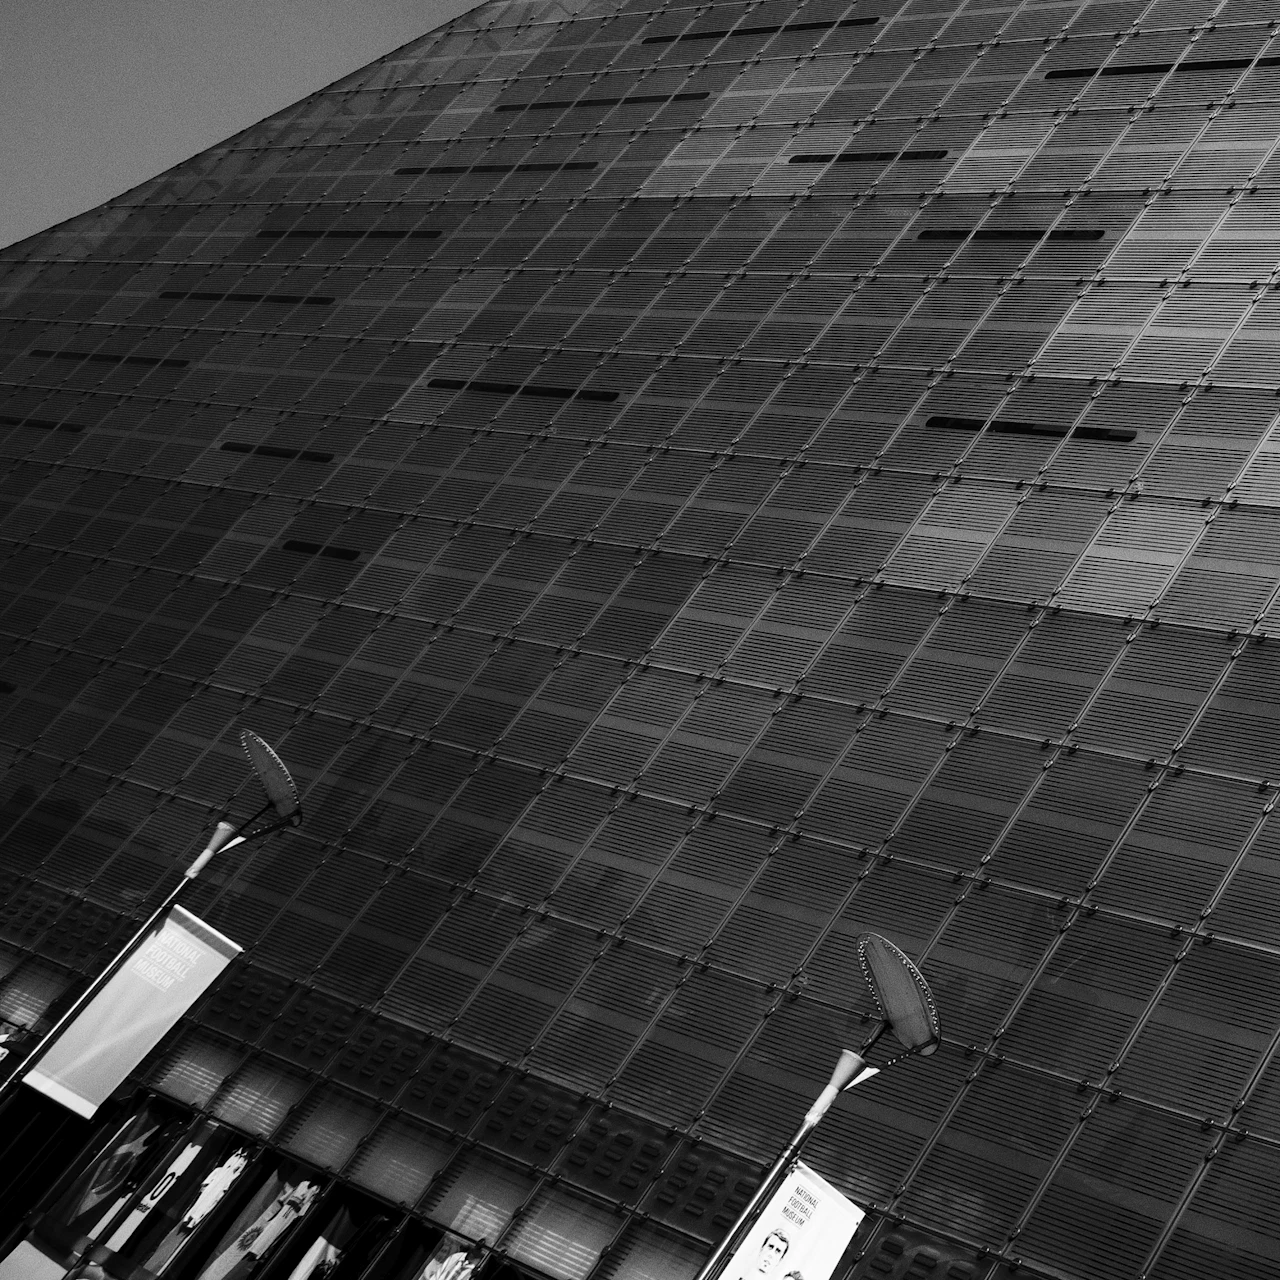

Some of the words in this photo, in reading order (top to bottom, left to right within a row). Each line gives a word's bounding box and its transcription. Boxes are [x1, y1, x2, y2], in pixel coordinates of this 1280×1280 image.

[157, 930, 202, 965] NATIONAL
[133, 958, 175, 989] MUSEUM
[145, 945, 190, 978] FOOTBALL
[787, 1196, 813, 1219] FOOTBALL
[795, 1186, 820, 1209] NATIONAL
[781, 1206, 805, 1227] MUSEUM
